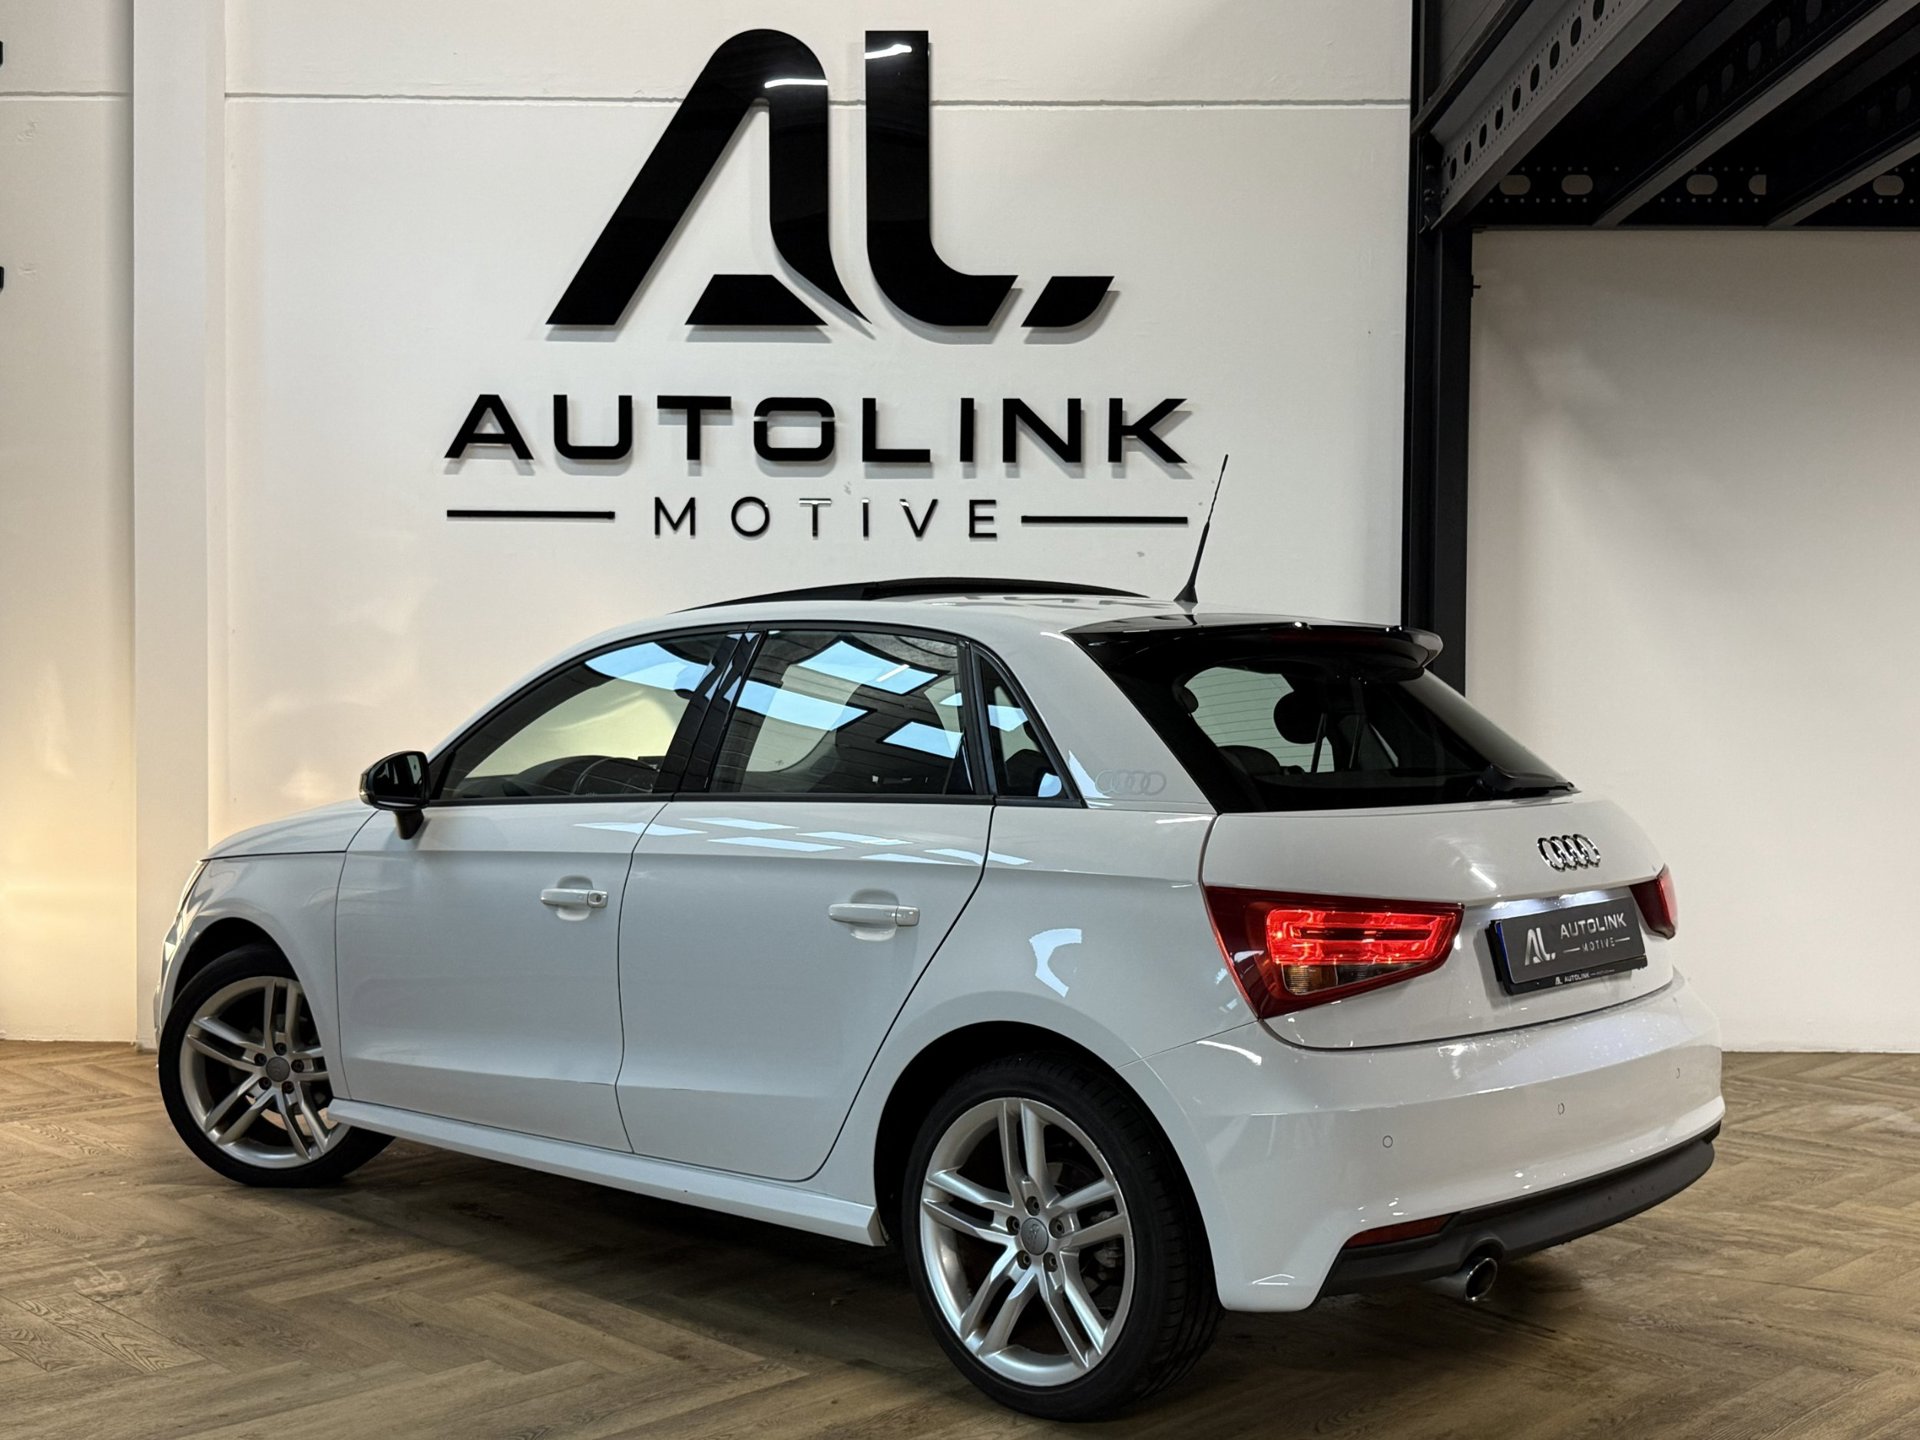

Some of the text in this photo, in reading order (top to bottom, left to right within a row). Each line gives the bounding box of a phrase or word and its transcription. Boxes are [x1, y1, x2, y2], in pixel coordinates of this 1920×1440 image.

[445, 394, 1188, 464] AUTOLINK
[654, 497, 998, 538] MOTIVE
[1560, 912, 1627, 940] AUTOLINK
[1582, 937, 1615, 952] MOTIVE
